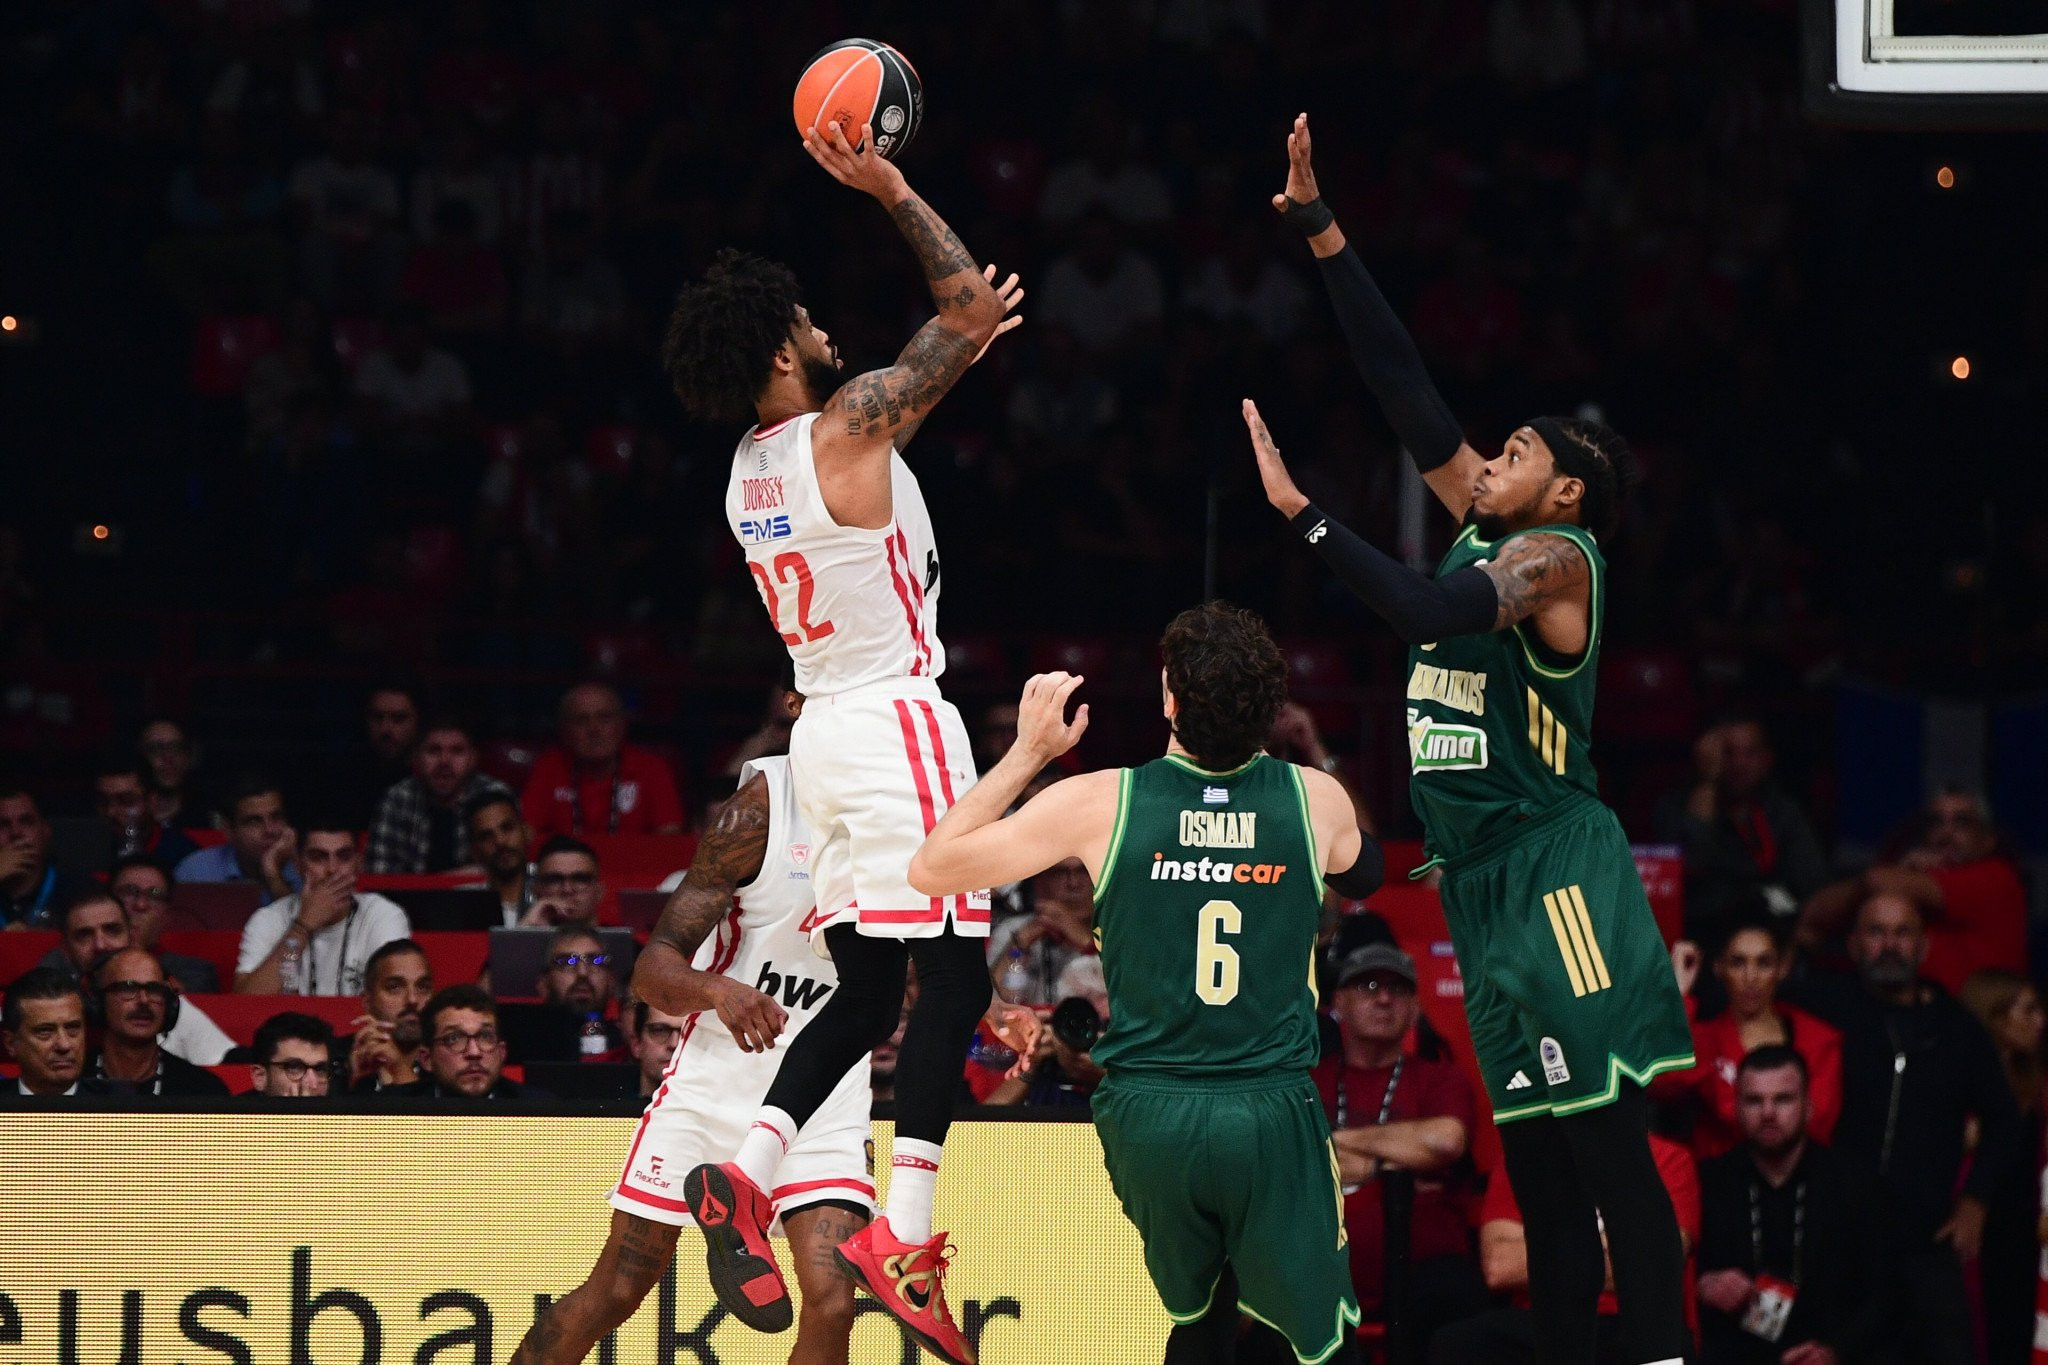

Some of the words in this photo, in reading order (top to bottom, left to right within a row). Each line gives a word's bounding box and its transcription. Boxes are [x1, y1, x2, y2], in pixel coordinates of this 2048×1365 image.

[742, 476, 784, 511] DORSEY
[1179, 809, 1257, 849] OSMAN
[1150, 851, 1287, 884] instacar
[1195, 899, 1243, 1006] 6
[634, 1169, 671, 1189] FlexCar
